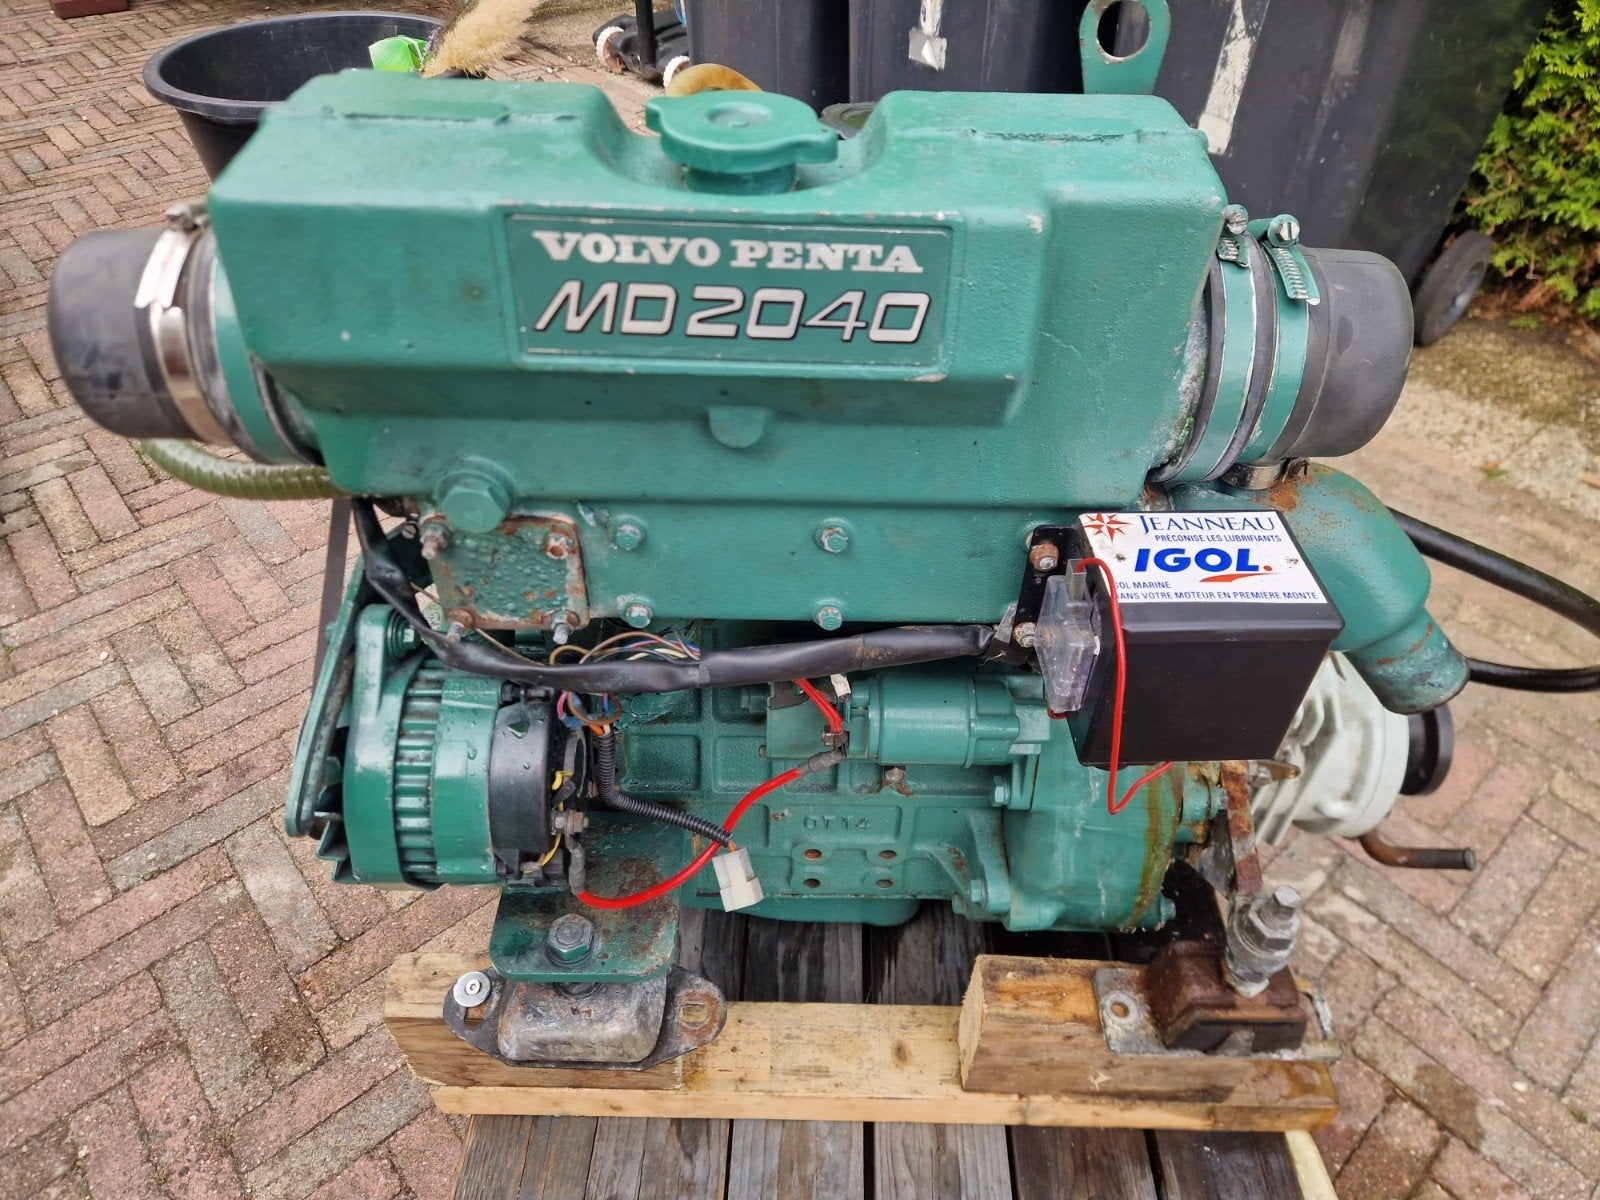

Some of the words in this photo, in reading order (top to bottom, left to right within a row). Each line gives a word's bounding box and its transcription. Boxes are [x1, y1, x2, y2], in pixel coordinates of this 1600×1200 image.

[532, 231, 721, 267] VOLVO
[730, 239, 924, 274] PENTA
[1137, 514, 1275, 535] JEANNEAU
[1206, 534, 1223, 542] LES
[1224, 534, 1282, 542] LUBRIFIANTS
[1113, 581, 1131, 589] GOL
[1132, 581, 1171, 589] MARINE
[1141, 592, 1174, 600] VOTRE
[1174, 591, 1216, 600] MOTEUR
[1217, 591, 1231, 599] EN
[1283, 591, 1319, 600] MONTE
